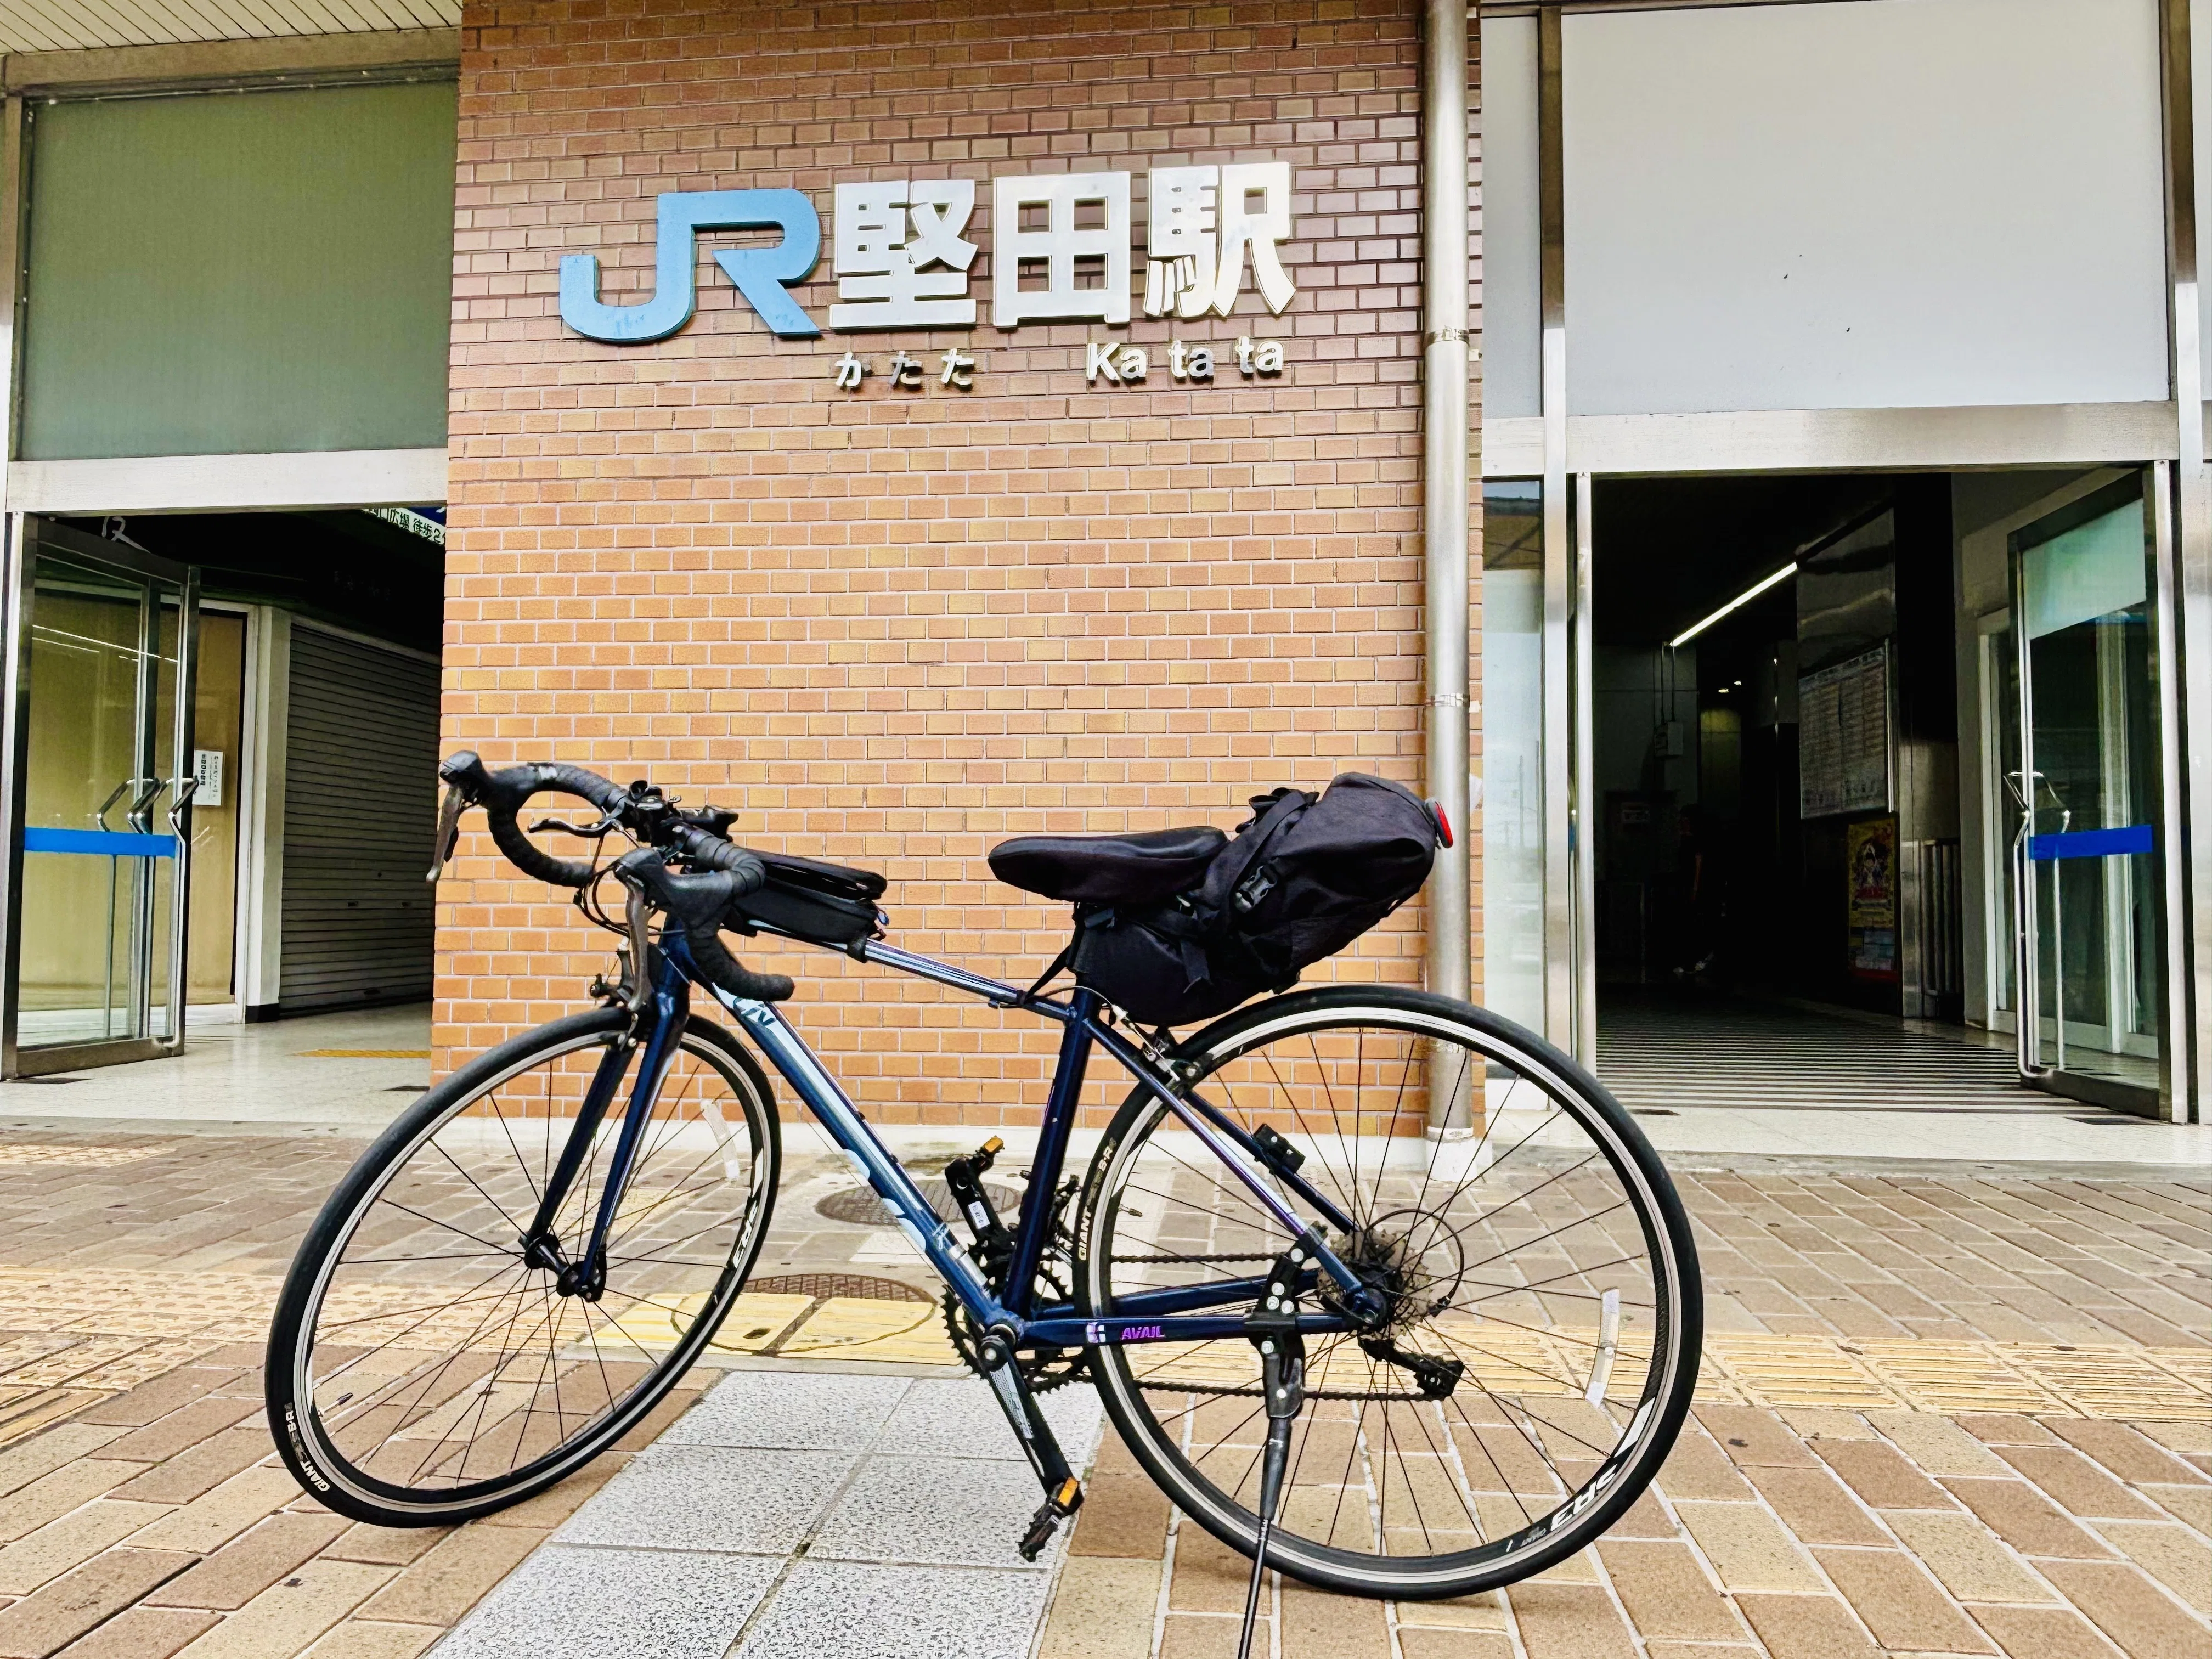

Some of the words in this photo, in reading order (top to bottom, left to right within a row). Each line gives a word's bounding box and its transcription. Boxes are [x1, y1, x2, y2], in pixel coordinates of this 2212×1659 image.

[559, 188, 821, 339] JR
[830, 162, 1297, 330] 堅田駅
[834, 348, 974, 387] かたた
[1086, 341, 1147, 382] Ka
[1167, 340, 1215, 379] ta
[1235, 335, 1285, 374] ta
[1078, 1206, 1092, 1261] GIANT
[1120, 1325, 1166, 1341] AVAIL
[300, 1460, 330, 1492] GIANT
